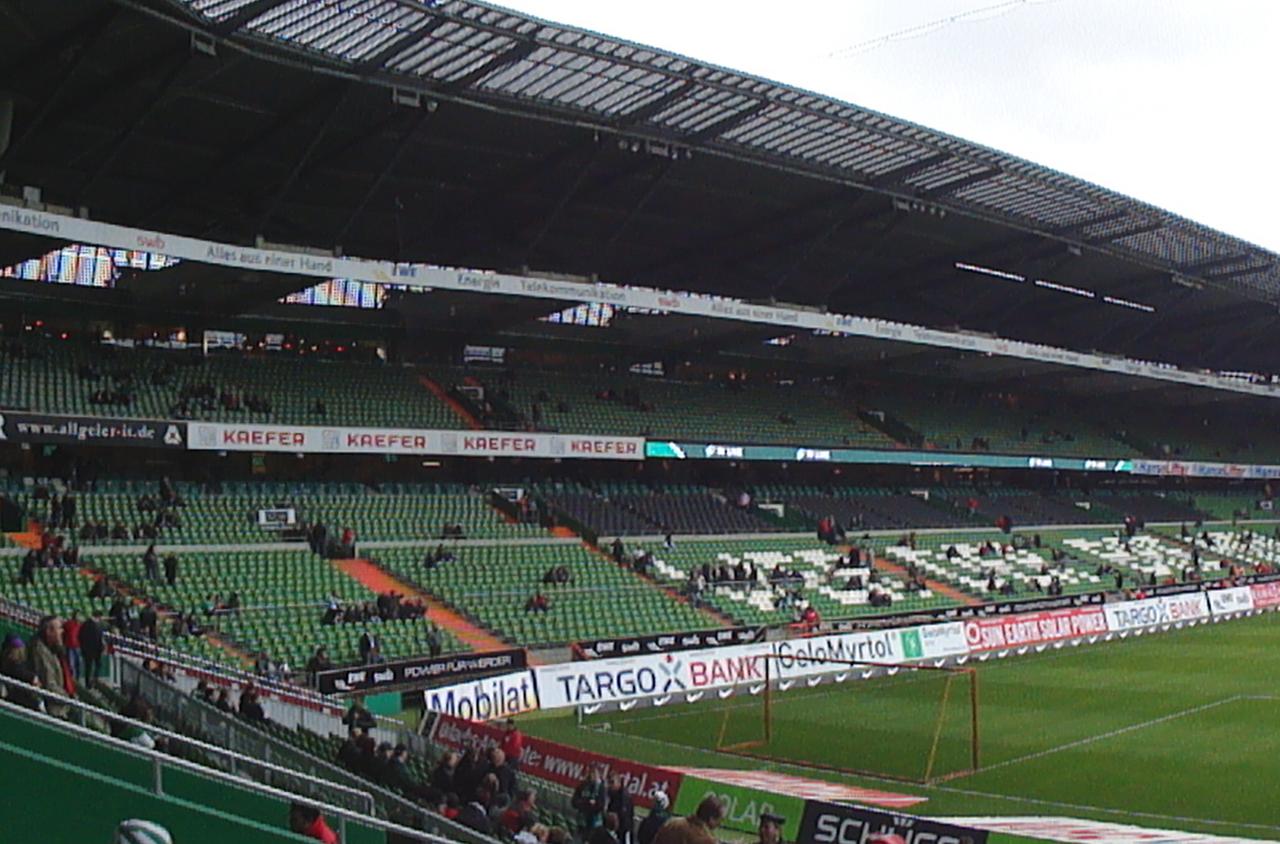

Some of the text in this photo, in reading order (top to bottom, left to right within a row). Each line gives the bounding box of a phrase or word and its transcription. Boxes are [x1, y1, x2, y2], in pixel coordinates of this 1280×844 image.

[16, 421, 156, 441] www.allgeier-it.de
[778, 631, 893, 669] GeloMyrtol
[431, 677, 530, 721] Mobilat
[557, 656, 764, 703] TARGO BANK
